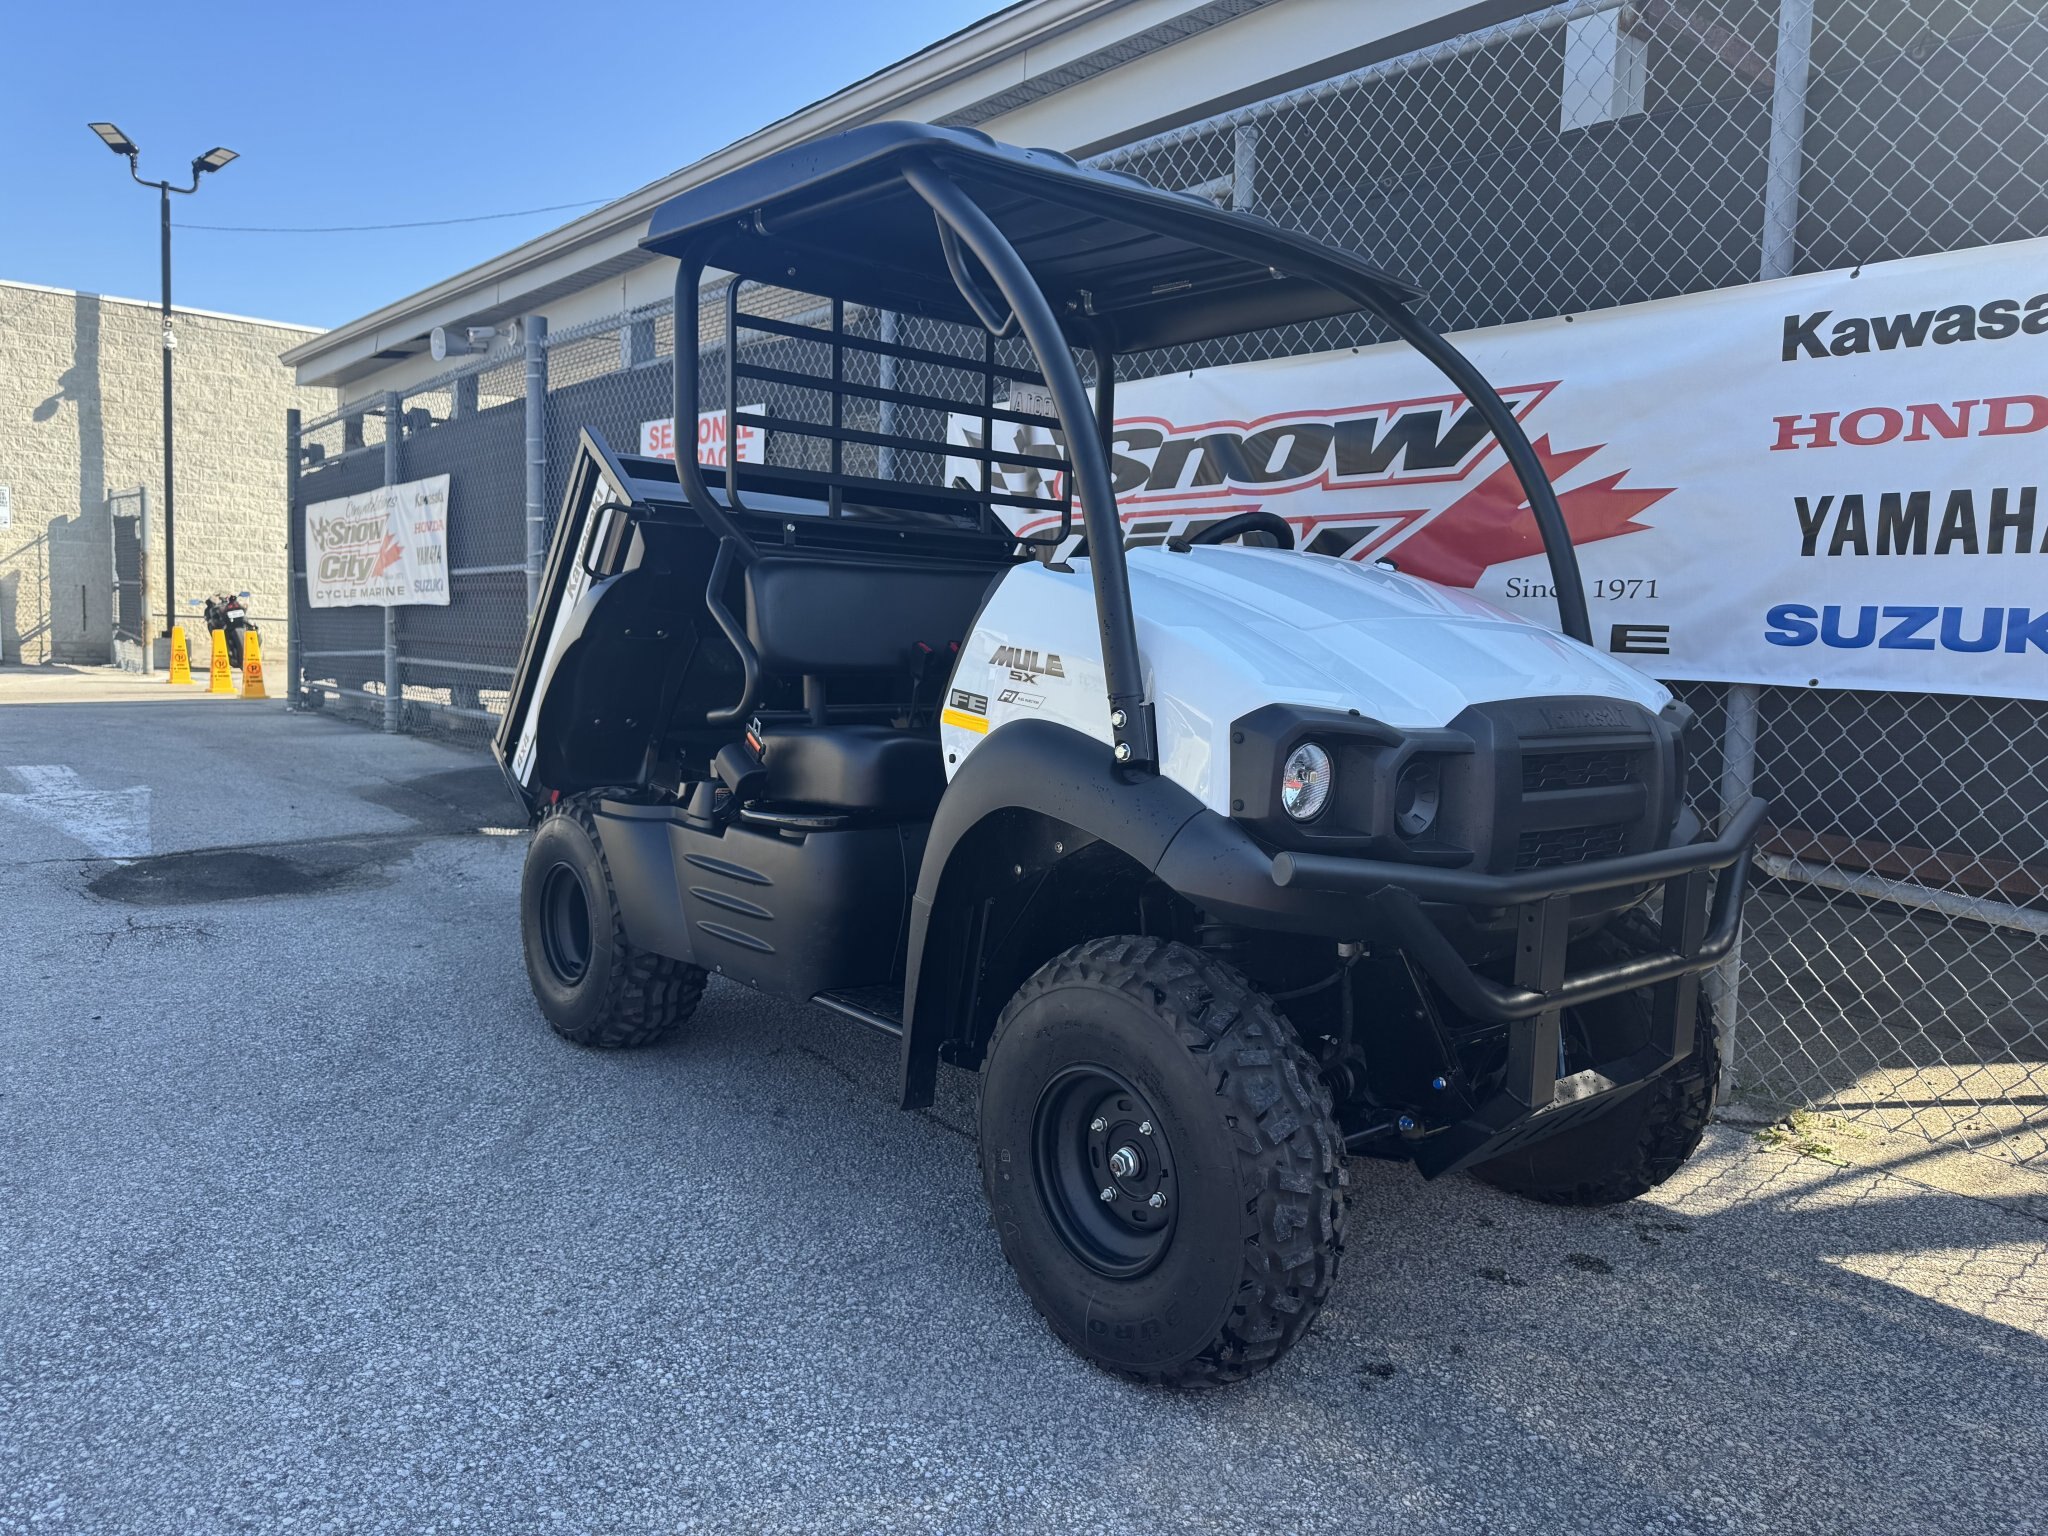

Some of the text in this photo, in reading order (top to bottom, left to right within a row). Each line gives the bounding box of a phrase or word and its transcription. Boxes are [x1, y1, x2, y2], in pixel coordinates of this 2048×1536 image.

[328, 518, 386, 547] Snow
[414, 519, 445, 535] HONDA
[1793, 486, 2048, 557] YAMAH
[319, 553, 376, 582] City
[416, 545, 442, 566] YAMAHA
[316, 586, 406, 599] CYCLE MARINE
[414, 578, 444, 593] SUZUKI
[1505, 577, 1659, 601] Sinc 1971
[988, 645, 1065, 678] MULE
[1009, 670, 1038, 686] SX
[951, 690, 987, 715] FE
[1539, 704, 1632, 731] Kawasaki
